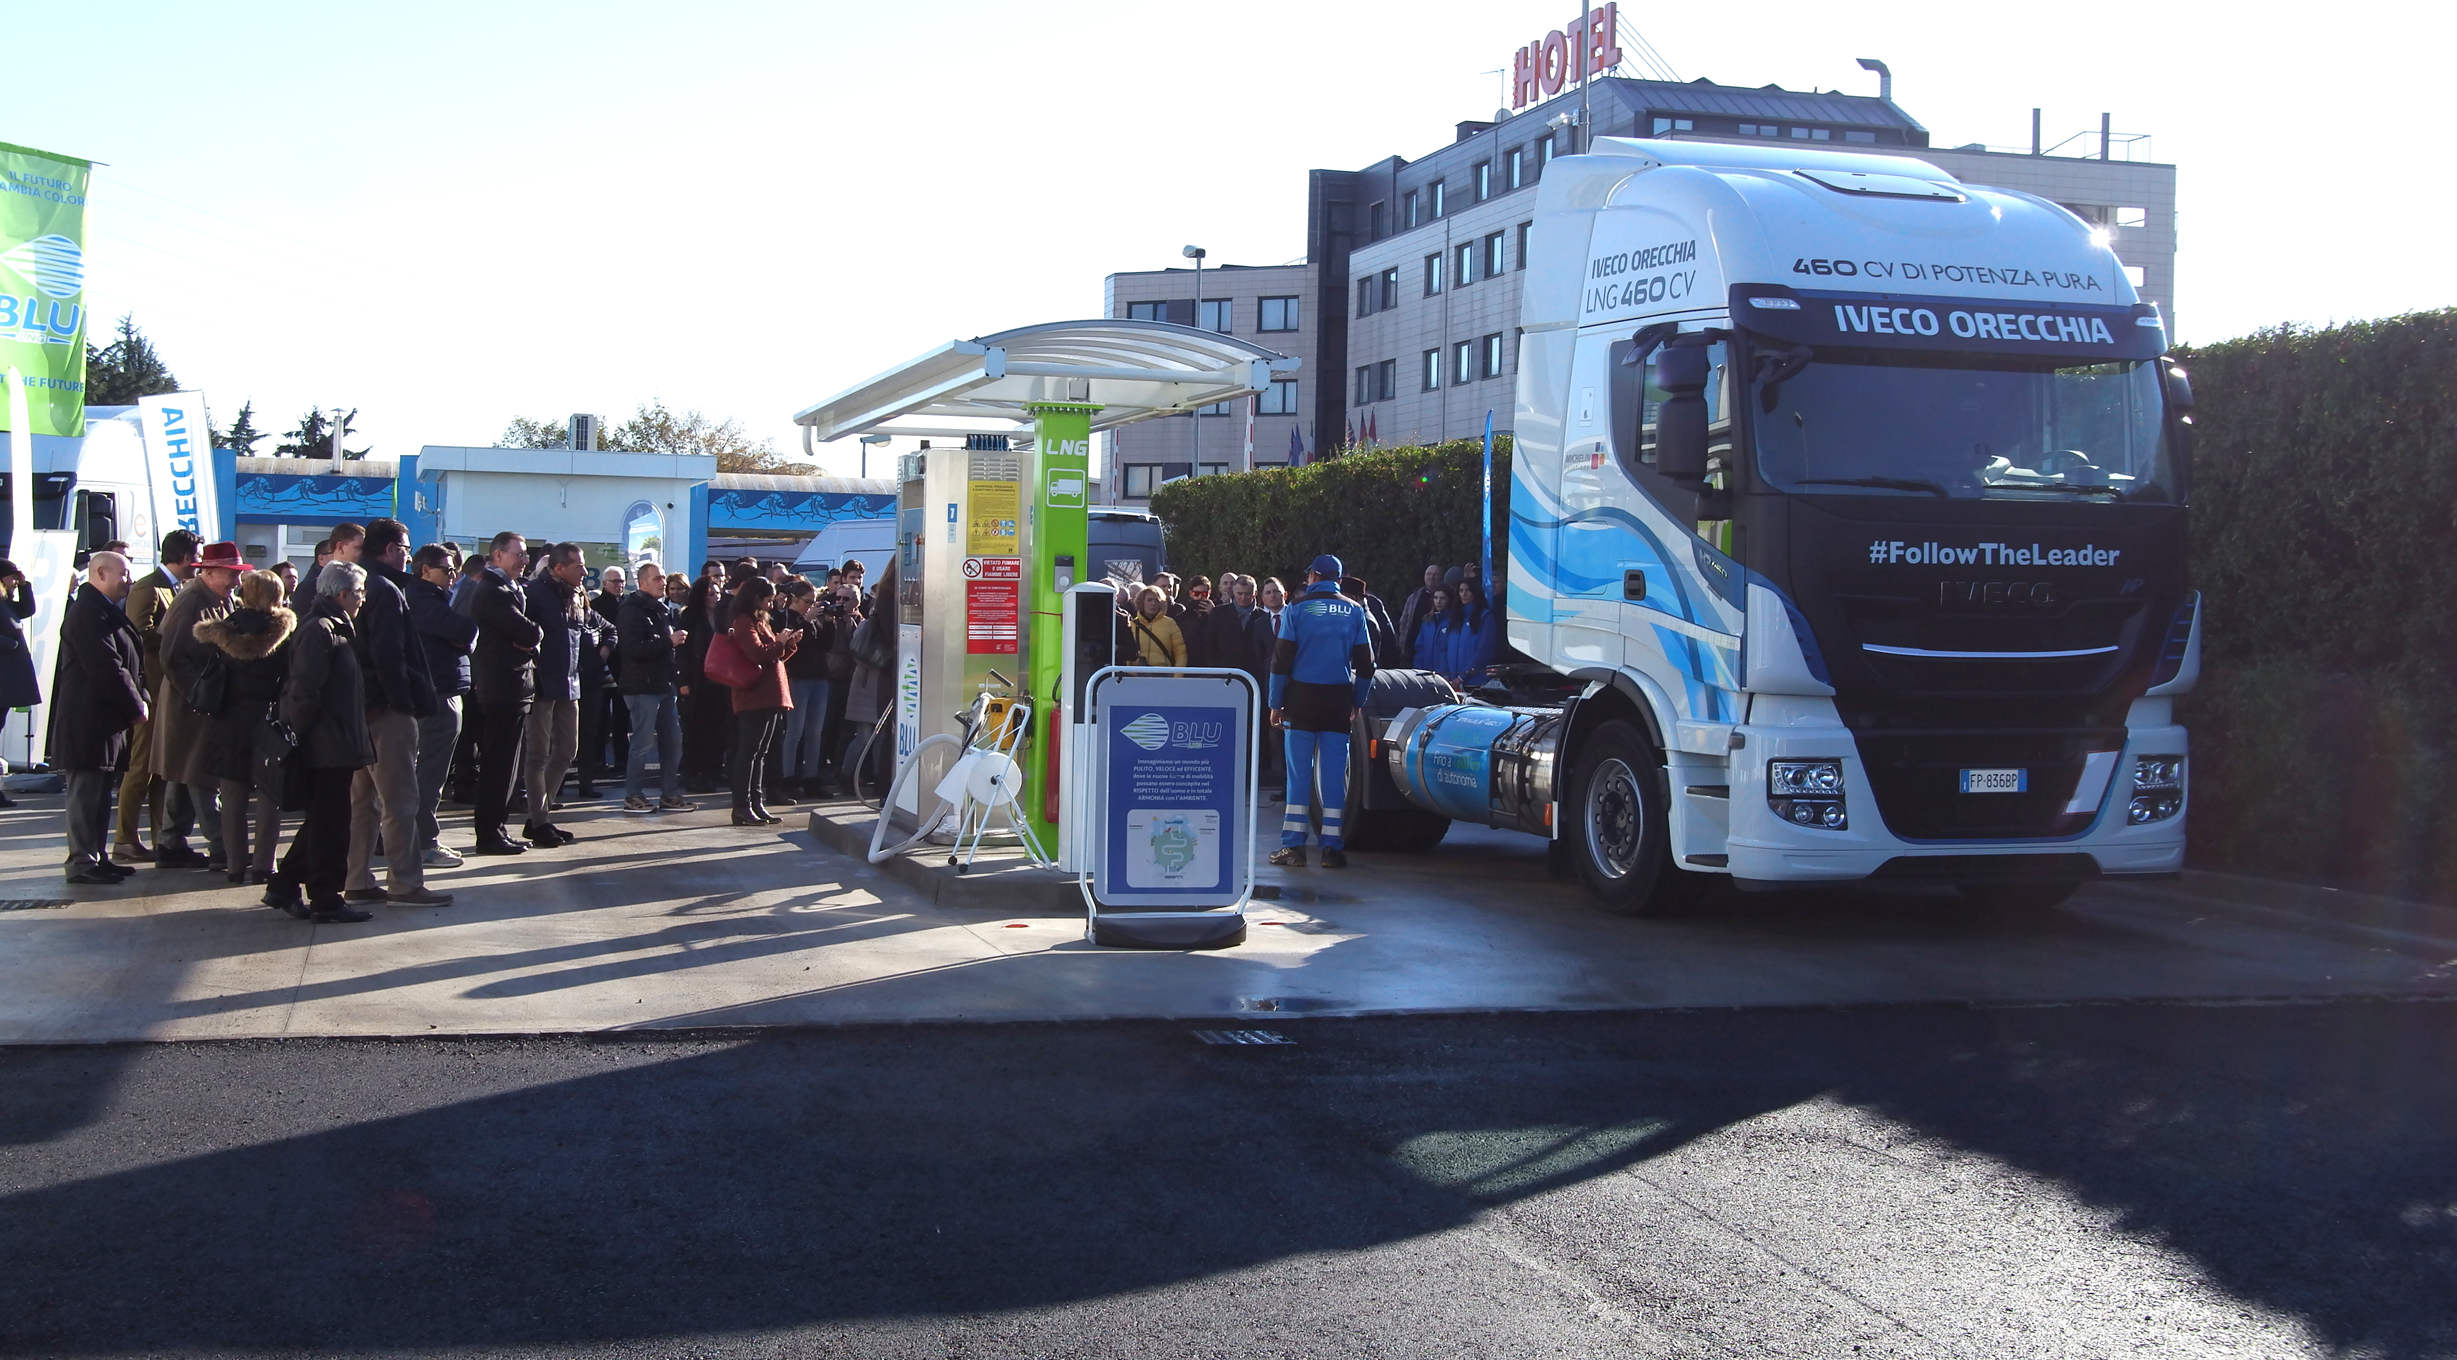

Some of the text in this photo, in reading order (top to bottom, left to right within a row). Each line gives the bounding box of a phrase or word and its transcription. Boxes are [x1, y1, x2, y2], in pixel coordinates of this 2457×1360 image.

[1512, 1, 1622, 110] HOTEL
[8, 170, 72, 191] IL FUTURO
[43, 190, 89, 207] COLORE
[1591, 239, 1696, 279] IVECO ORECCHIA
[1792, 258, 2103, 292] 460 CV DI POTENZA PURA
[1585, 269, 1697, 314] LNG 460 CV
[0, 294, 80, 336] BLU
[1833, 304, 2115, 344] IVECO ORECCHIA
[39, 377, 84, 393] FUTURE
[1045, 438, 1088, 457] LNG
[1869, 540, 2121, 567] #FollowTheLeader
[1940, 581, 2053, 604] IVECO
[1329, 604, 1352, 615] BLU
[1171, 721, 1223, 743] BLU
